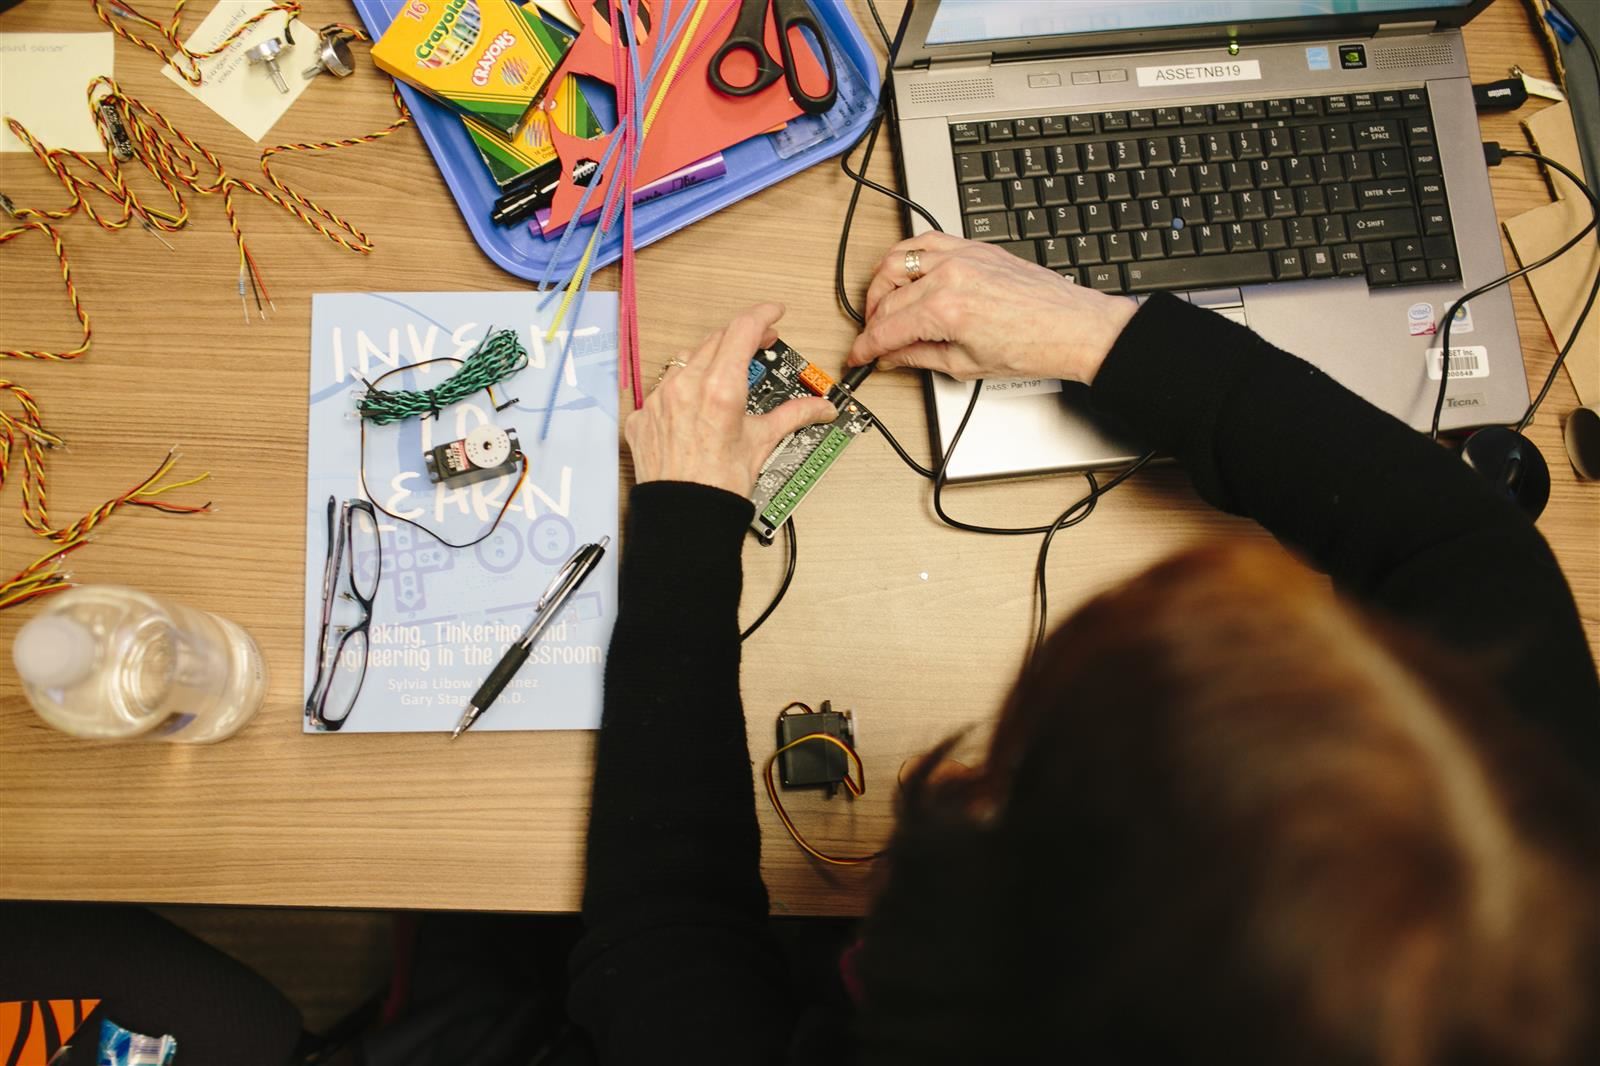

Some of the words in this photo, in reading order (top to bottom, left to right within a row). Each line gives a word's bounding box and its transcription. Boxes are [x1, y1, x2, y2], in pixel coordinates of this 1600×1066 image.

[405, 0, 429, 21] 16
[416, 0, 466, 59] Crayola
[472, 29, 517, 87] CRAYONS
[1156, 64, 1241, 81] ASSETNB19
[1211, 142, 1217, 151] 8
[1242, 140, 1247, 148] 9
[1272, 138, 1277, 146] 0
[1119, 150, 1126, 159] 5
[1151, 147, 1156, 155] 6
[1058, 155, 1063, 163] 3
[1088, 152, 1094, 161] 4
[995, 159, 1000, 168] 1
[1026, 157, 1032, 166] 2
[1261, 161, 1268, 170] O
[1291, 159, 1297, 167] P
[1170, 168, 1176, 177] Y
[1200, 166, 1207, 175] U
[1108, 173, 1115, 182] R
[1139, 171, 1145, 180] T
[1045, 178, 1053, 187] W
[1078, 176, 1084, 185] E
[1014, 181, 1022, 190] Q
[1243, 193, 1251, 202] K
[1274, 191, 1280, 200] L
[1152, 200, 1159, 209] G
[1183, 198, 1190, 207] H
[1214, 196, 1219, 205] J
[1090, 206, 1096, 215] D
[1121, 203, 1127, 212] F
[1028, 211, 1034, 220] A
[1059, 208, 1065, 217] S
[1203, 227, 1210, 236] N
[1233, 225, 1241, 233] M
[1111, 235, 1117, 244] C
[1141, 232, 1147, 241] V
[1172, 231, 1179, 240] B
[1047, 240, 1054, 249] Z
[1078, 237, 1086, 246] X
[357, 464, 573, 534] LEARN
[325, 646, 431, 672] Engineering
[438, 645, 453, 666] in
[464, 644, 493, 665] the
[501, 644, 603, 665] Cssroom
[388, 678, 428, 692] Sylvia
[432, 677, 473, 690] Libow
[401, 694, 433, 707] Gary
